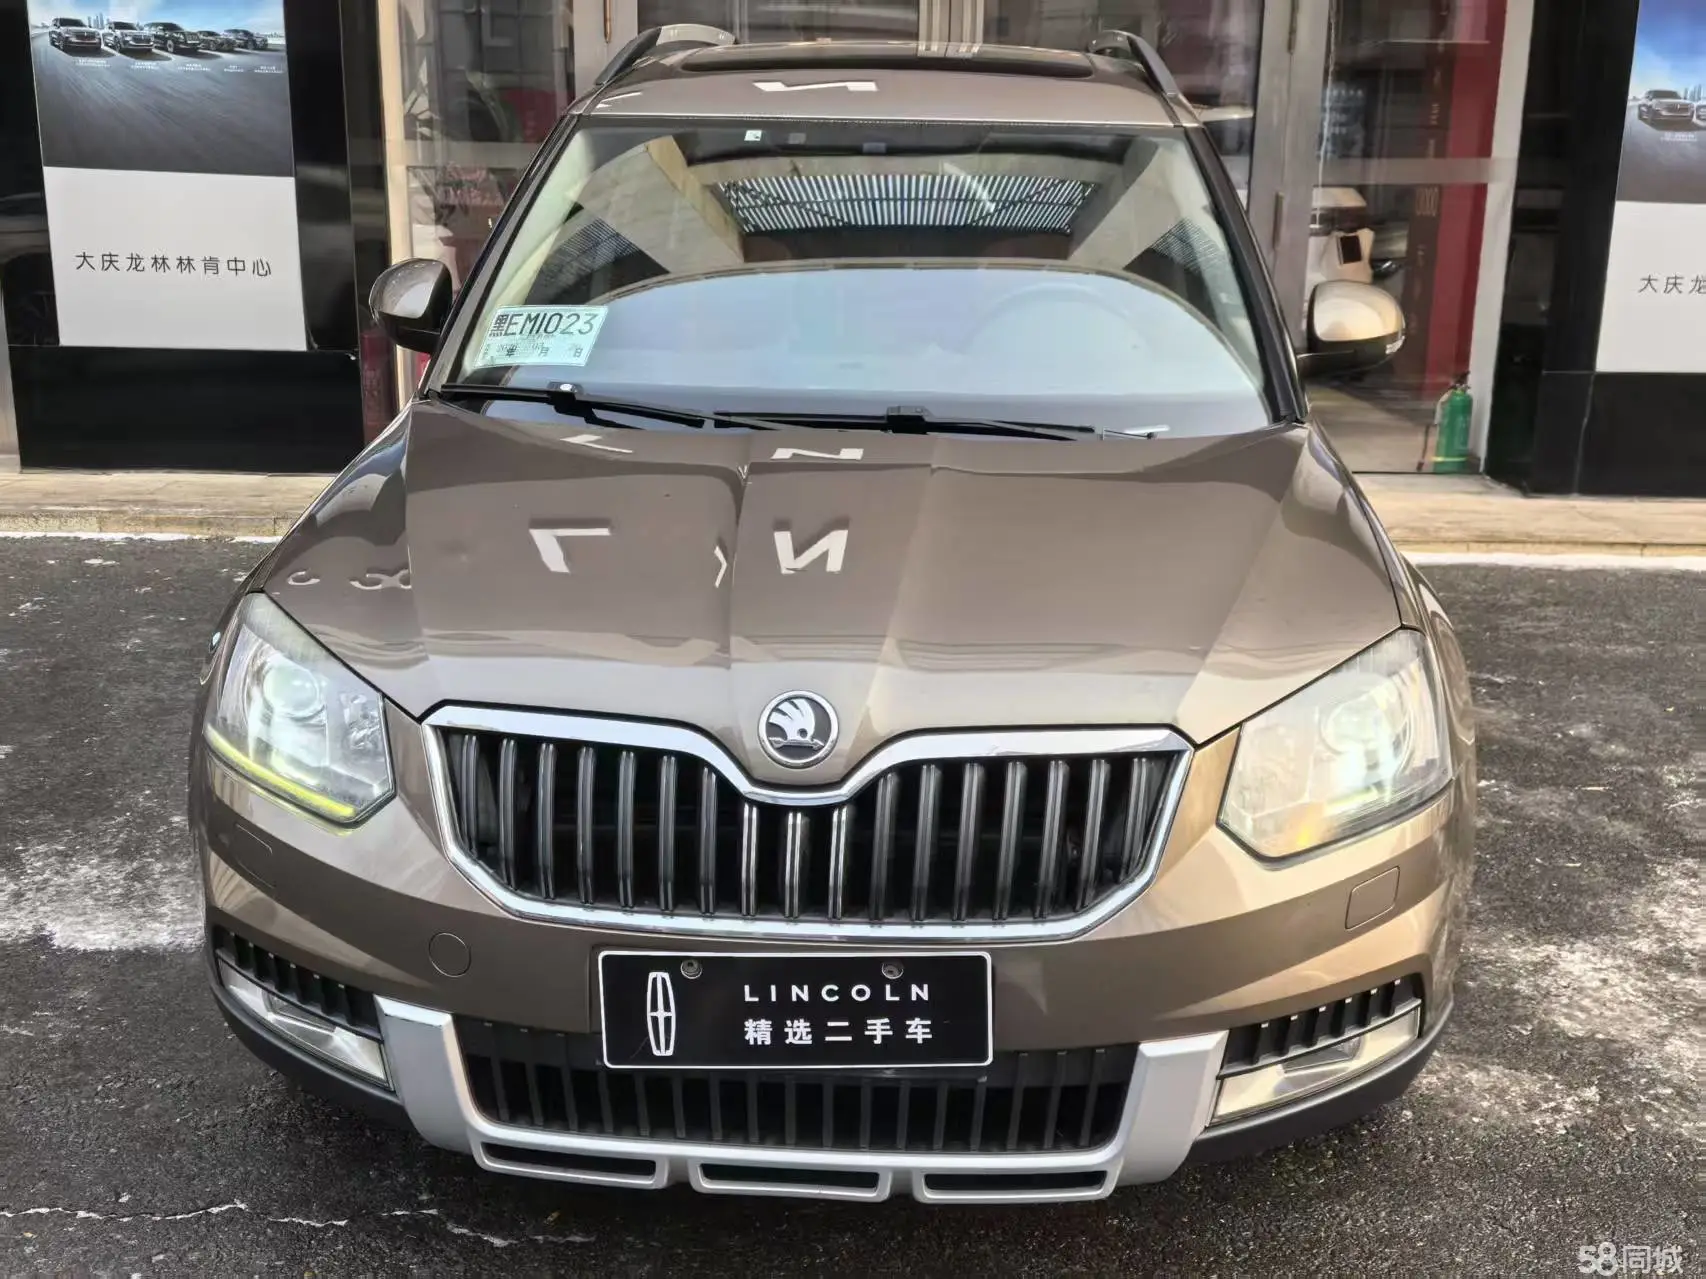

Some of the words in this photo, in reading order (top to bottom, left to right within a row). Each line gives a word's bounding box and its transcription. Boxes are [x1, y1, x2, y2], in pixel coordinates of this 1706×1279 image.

[75, 251, 272, 277] 大庆龙林林肯中心
[743, 983, 930, 1003] LINCOLN
[743, 1017, 934, 1046] 精选二手车
